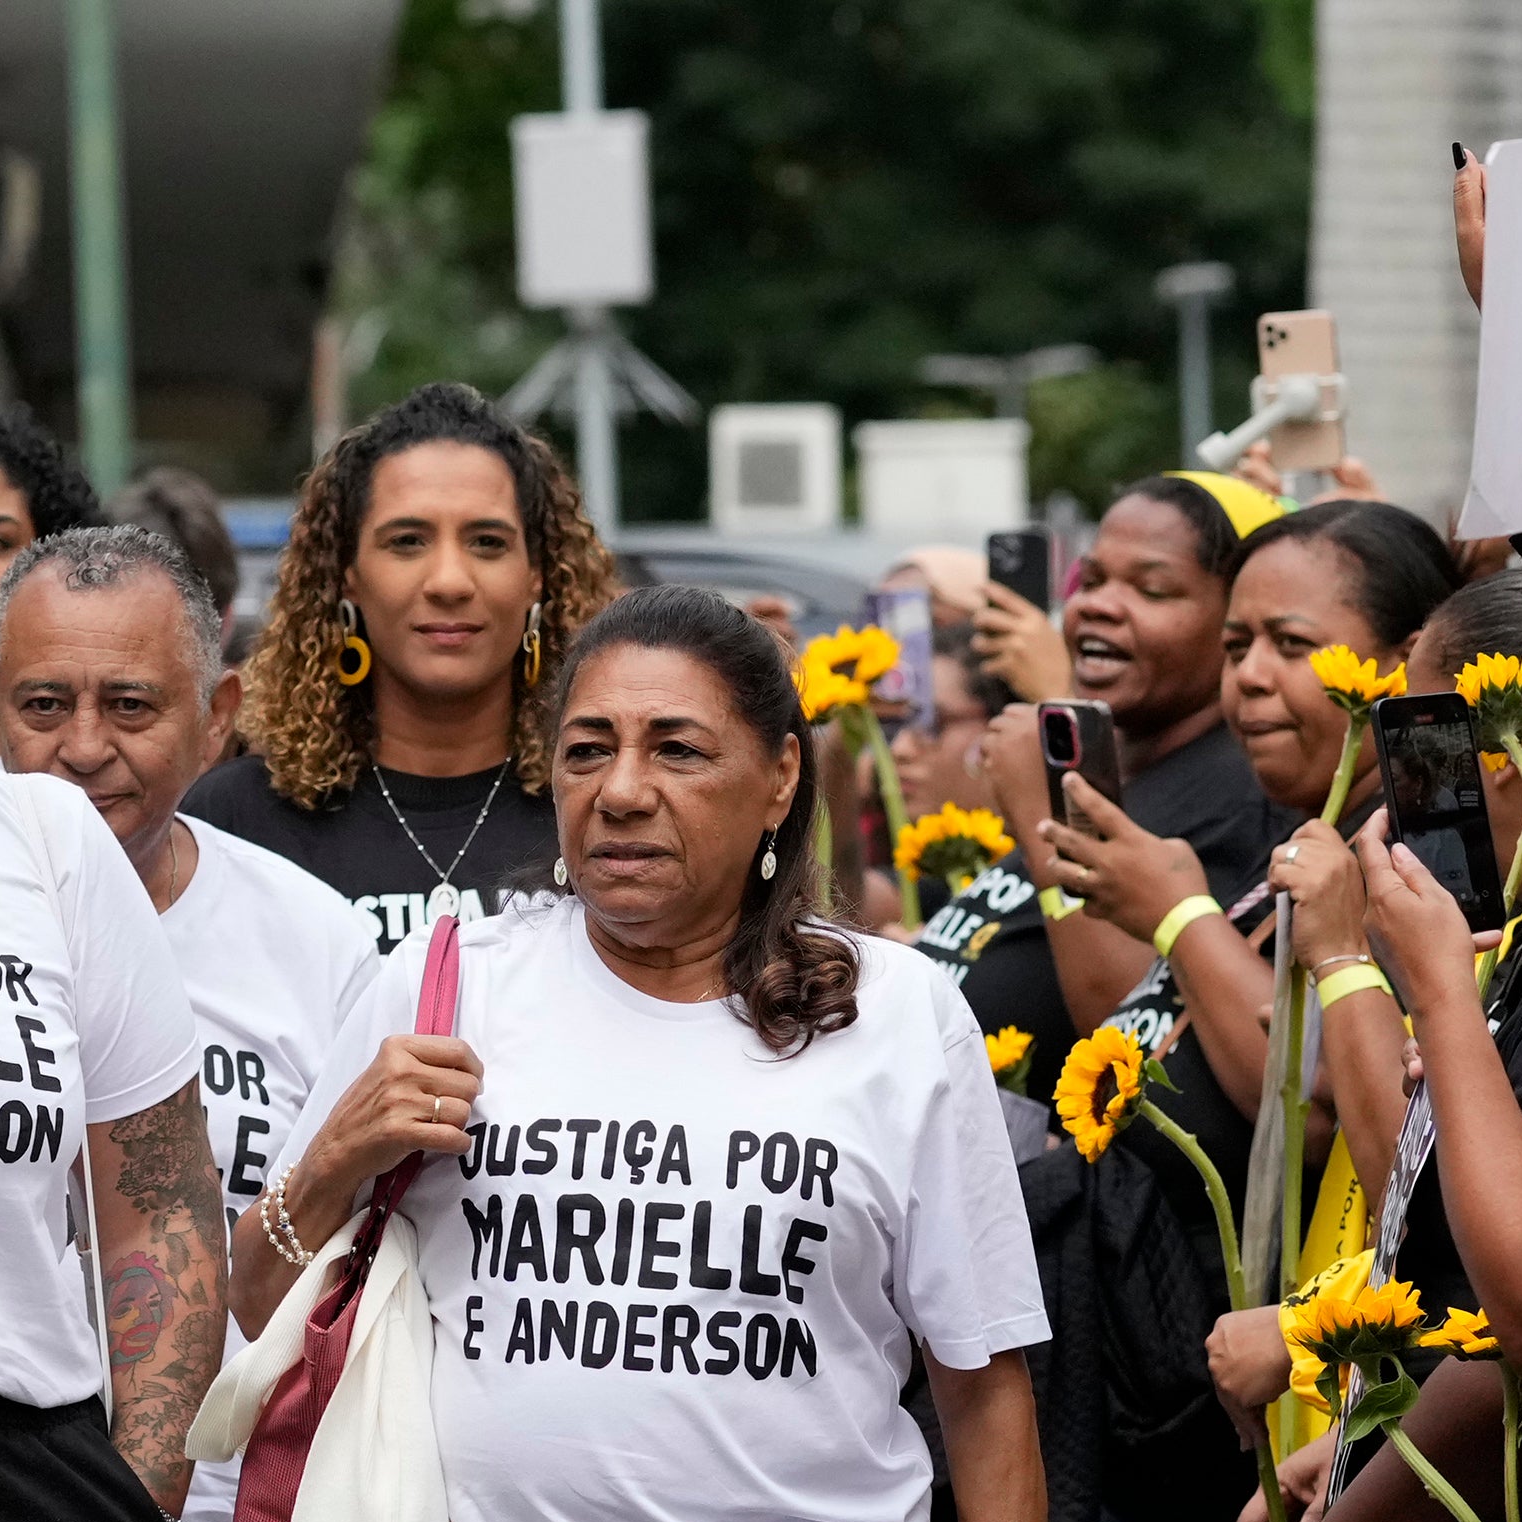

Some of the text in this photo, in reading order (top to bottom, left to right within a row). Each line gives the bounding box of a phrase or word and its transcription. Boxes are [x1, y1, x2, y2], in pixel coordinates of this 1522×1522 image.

[203, 1044, 271, 1106] OR
[458, 1118, 839, 1207] JUSTIÇA POR
[1338, 1177, 1360, 1231] POR
[461, 1193, 828, 1304] MARIELLE
[463, 1295, 817, 1380] E ANDERSON
